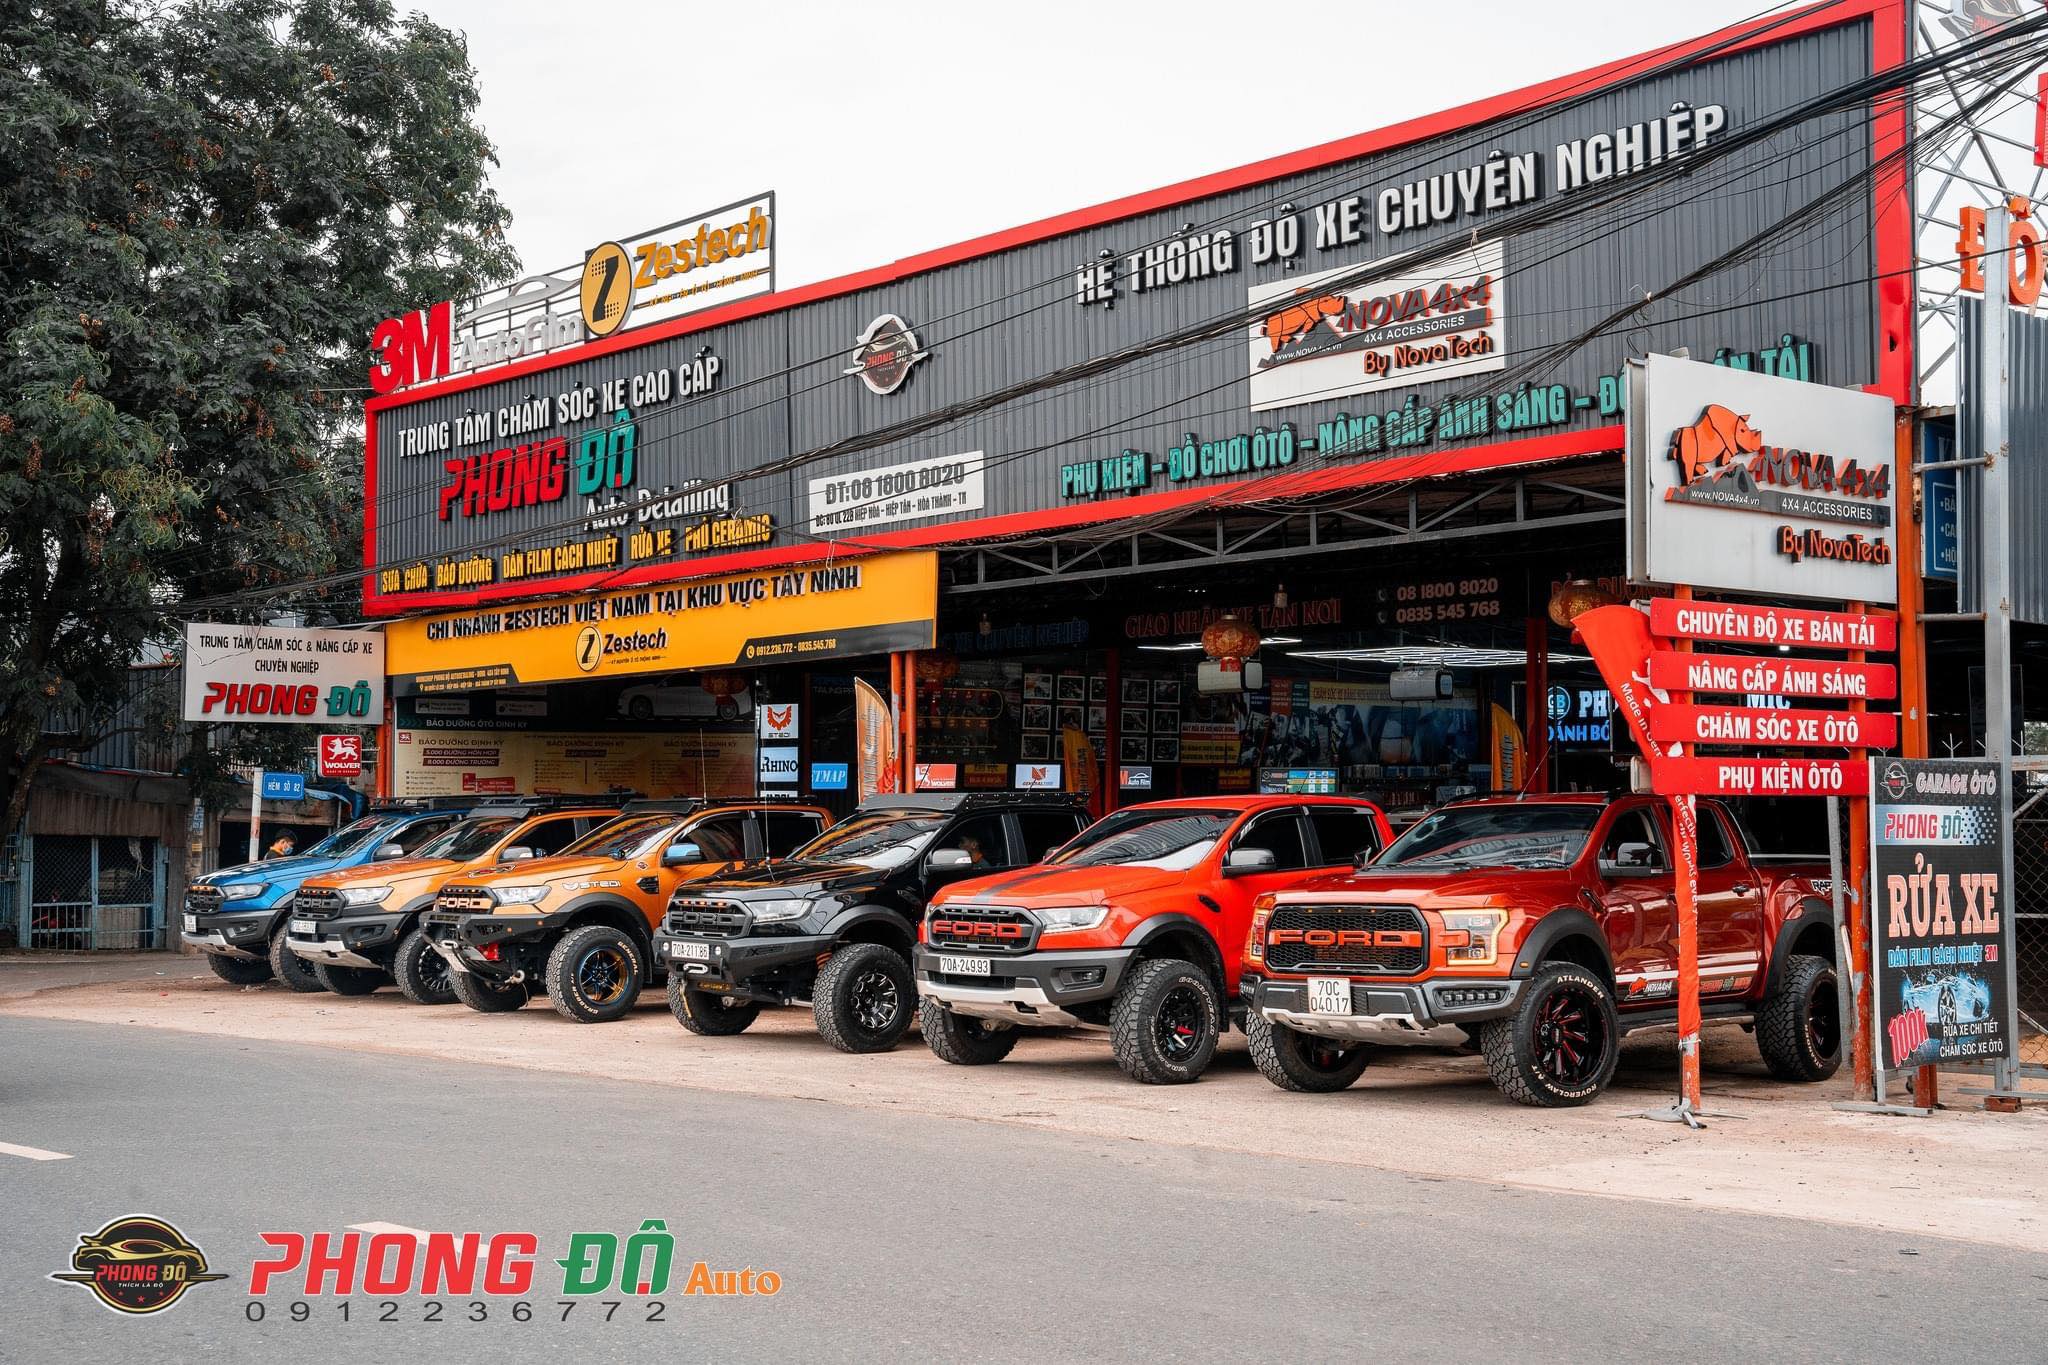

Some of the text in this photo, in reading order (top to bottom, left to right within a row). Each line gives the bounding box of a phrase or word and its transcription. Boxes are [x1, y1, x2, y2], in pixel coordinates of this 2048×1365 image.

[1076, 102, 1728, 309] HỆ THỐNG ĐỘ XE CHUYÊN NGHIỆP
[634, 206, 772, 289] Zestech
[1364, 315, 1465, 344] 4X4 ACCESSORIES
[369, 301, 455, 395] 3M
[1363, 351, 1390, 377] By
[398, 345, 722, 457] TRUNG TÂM CHĂM SÓC XE CAO CẤP
[1061, 460, 1098, 502] PHỤ
[1101, 448, 1149, 496] KIỆN
[1169, 433, 1198, 483] ĐỒ
[1253, 421, 1297, 469] ÔTÔ
[1318, 415, 1382, 458] NÂNG
[1384, 395, 1433, 452] CẤP
[1438, 386, 1493, 441] ÁNH
[1497, 382, 1568, 432] SÁNG
[439, 408, 639, 520] PHONG ĐỘ
[876, 470, 916, 496] 1800
[919, 462, 965, 489] 8020
[1691, 488, 1760, 506] www.NOVA4x4.vn
[1782, 497, 1873, 521] 4X4 ACCESSORIES
[503, 549, 524, 579] DÁN
[526, 547, 552, 574] FILM
[554, 538, 583, 570] CÁCH
[586, 534, 618, 568] NHIỆT
[657, 529, 671, 555] XE
[1780, 526, 1804, 562] By
[1397, 578, 1498, 600] 08 1800 8020
[427, 566, 860, 641] CHI NHÁNH ZESTECH VIỆT NAM TẠI KHU VỰC TÂY NINH
[1397, 601, 1499, 623] 0835 545 768
[1677, 608, 1874, 645] CHUYÊN ĐỘ XE BÁN TẢI
[200, 633, 373, 654] TRUNG TÂM CHĂM SÓC & NÂNG CẤP XE
[603, 627, 667, 654] Zestech
[254, 658, 320, 675] CHUYÊN NGHIỆP
[1688, 660, 1866, 696] NÂNG CẤP ÁNH SÁNG
[201, 680, 372, 717] PHONG ĐỘ
[1620, 682, 1641, 716] Made
[1696, 713, 1859, 743] CHĂM SÓC XE ÔTÔ
[324, 761, 361, 769] WOLVER
[760, 757, 798, 773] RHINO
[1719, 761, 1842, 793] PHỤ KIỆN ÔTÔ
[1915, 769, 1997, 796] GARAGE ÔTÔ
[1884, 812, 1938, 840] PHONG
[580, 881, 622, 889] STEDI
[1887, 852, 2000, 938] RỬA XE
[295, 897, 334, 910] FORD
[439, 898, 481, 909] FORD
[670, 911, 734, 926] FORD
[932, 920, 1022, 938] FORD
[1269, 930, 1422, 947] FORD
[617, 941, 639, 975] GENERAL
[1888, 942, 1998, 968] DÁN FILM CÁCH NHIỆT 3M
[1318, 980, 1340, 996] 70C
[1557, 975, 1605, 999] ATLANDER
[1179, 976, 1216, 1036] GOODYEAR
[1310, 996, 1349, 1013] 040.17
[1888, 1007, 1929, 1067] 100K
[1942, 1018, 1998, 1037] RỬA XE CHI TIẾT
[1939, 1038, 2003, 1057] CHĂM SÓC XE ÔTÔ
[1545, 1083, 1597, 1099] ROVERCLAW
